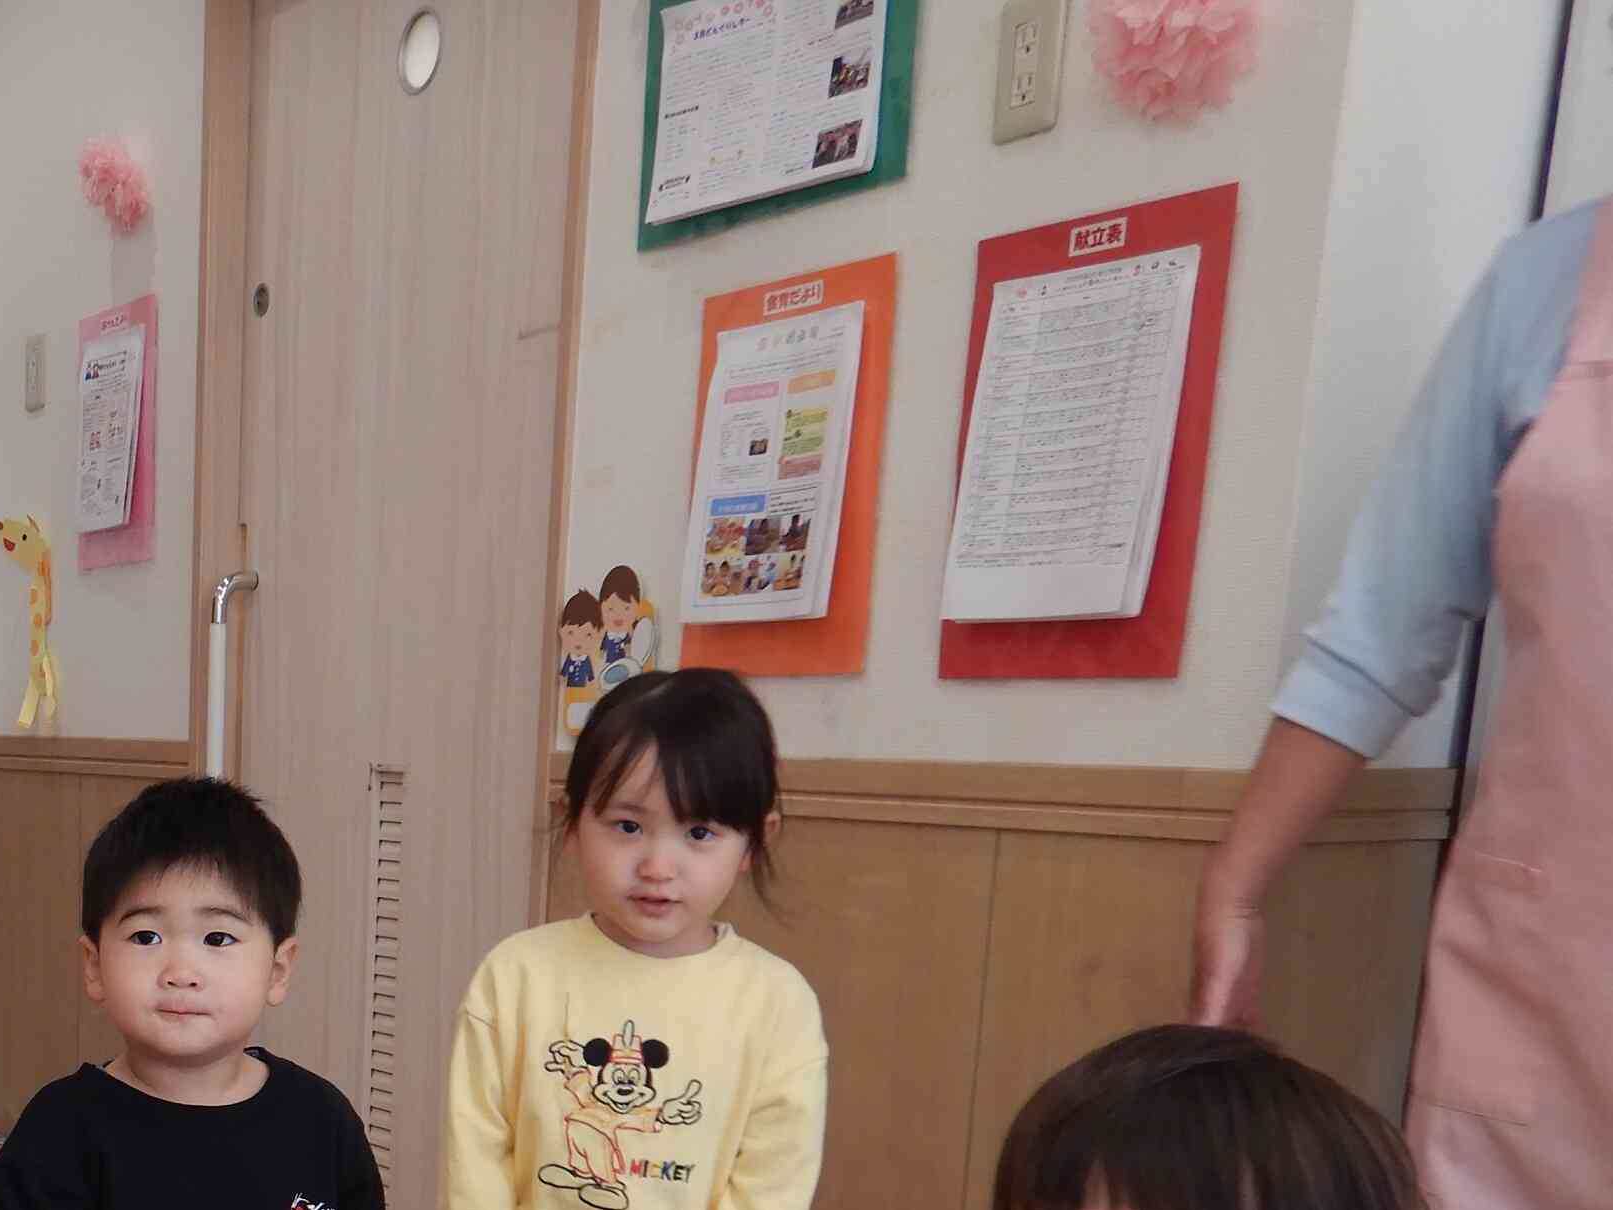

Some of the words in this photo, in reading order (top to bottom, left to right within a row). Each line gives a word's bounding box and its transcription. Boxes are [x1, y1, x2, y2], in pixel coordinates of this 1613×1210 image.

[1074, 223, 1124, 251] 献立表
[766, 283, 821, 312] 食育だより
[630, 1157, 697, 1184] MICKEY
